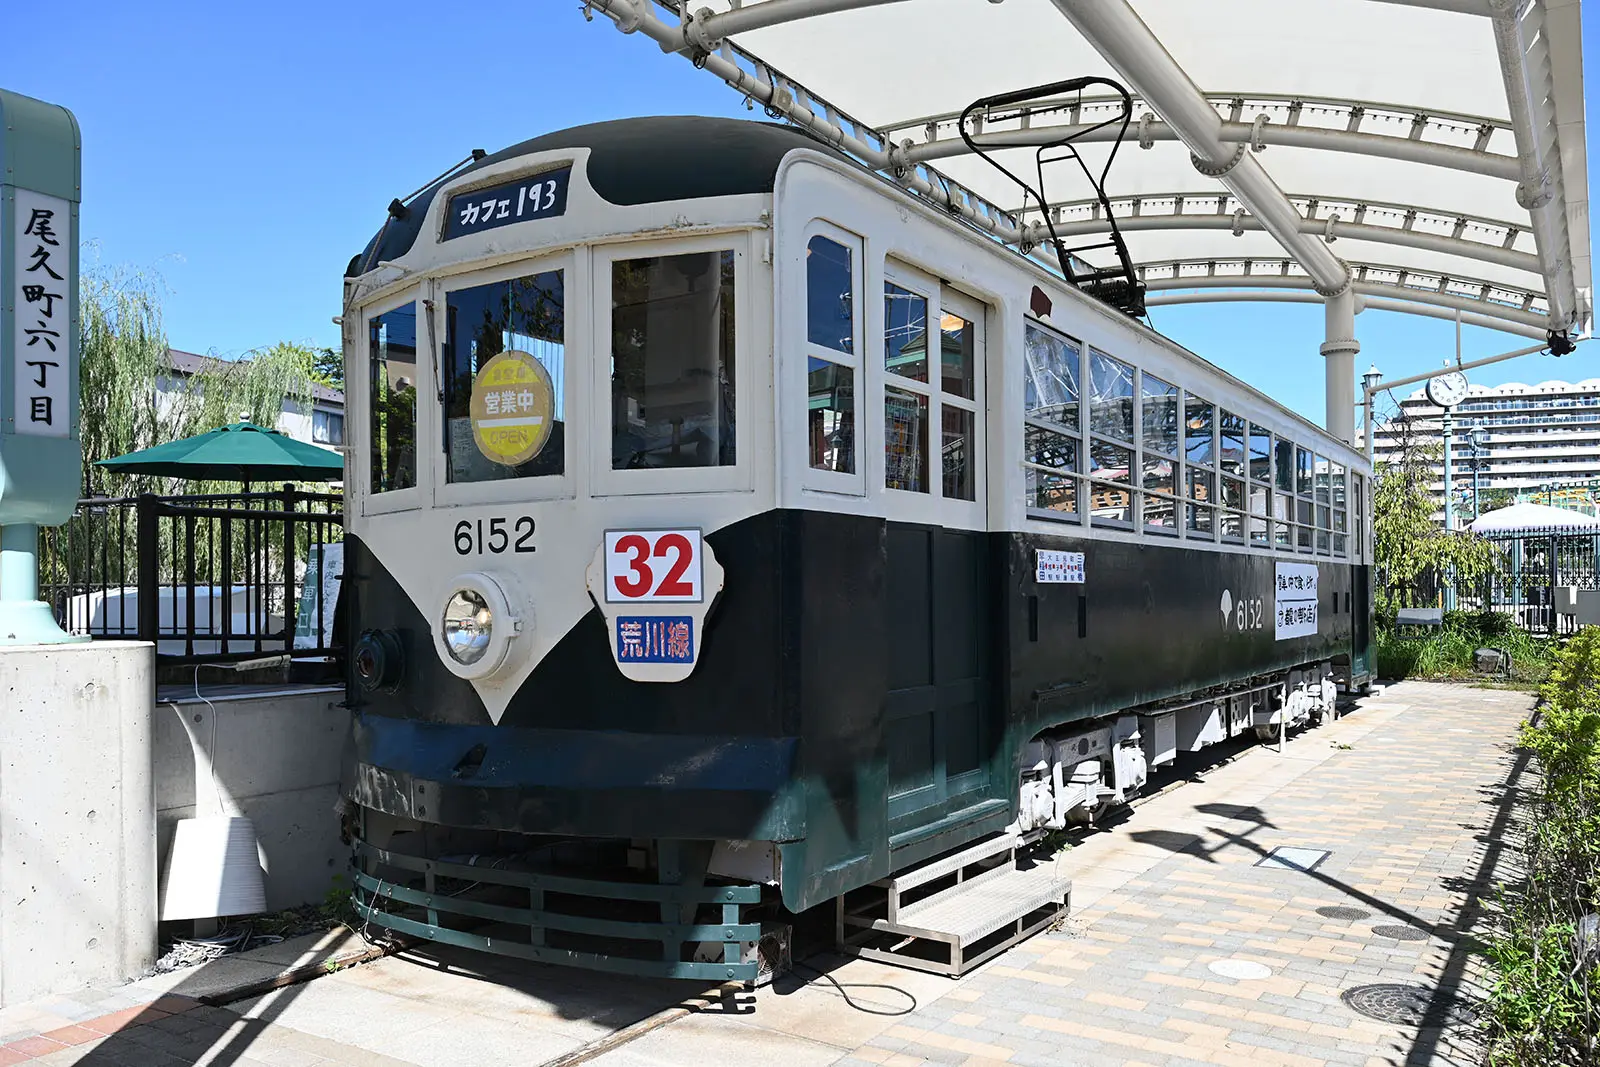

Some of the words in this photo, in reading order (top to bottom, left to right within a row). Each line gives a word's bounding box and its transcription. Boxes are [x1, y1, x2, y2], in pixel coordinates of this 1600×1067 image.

[22, 208, 64, 426] 尾久町六丁目
[484, 388, 535, 415] 営業中
[489, 429, 529, 445] OPEN
[454, 516, 536, 555] 6152
[613, 533, 694, 598] 32
[297, 558, 318, 628] 乗車口
[1237, 599, 1263, 630] 6152
[620, 620, 691, 659] 荒川線
